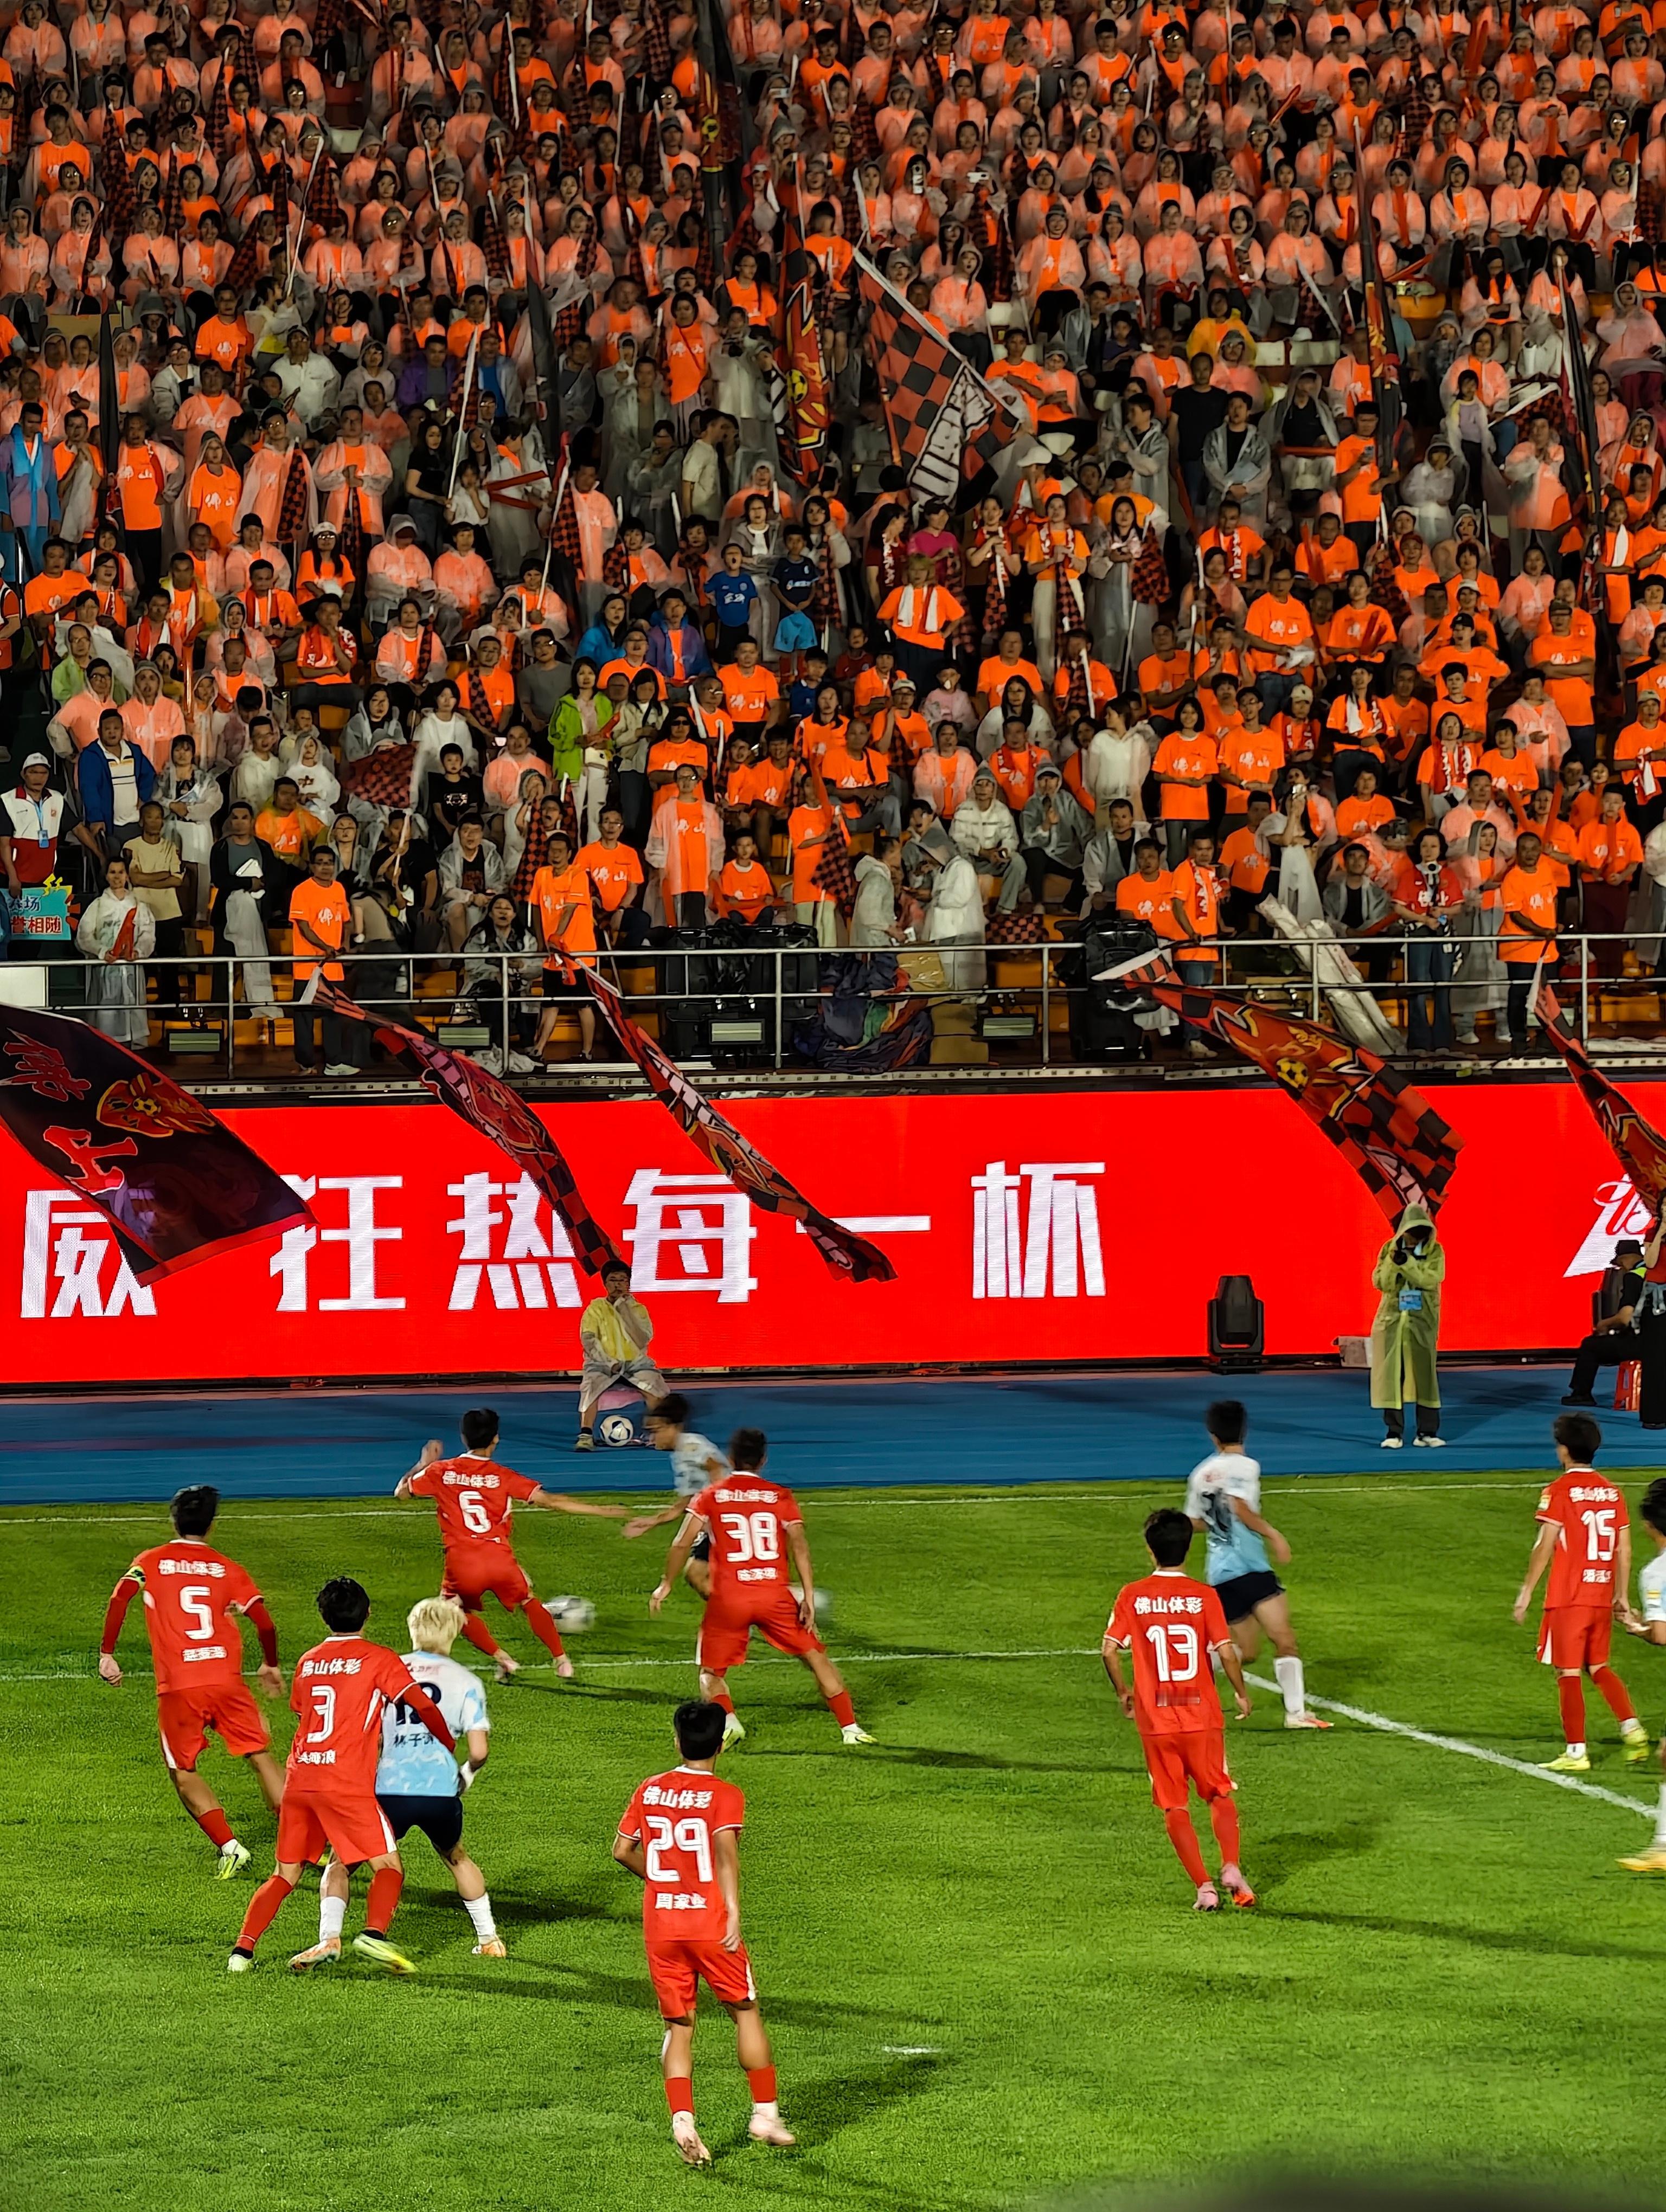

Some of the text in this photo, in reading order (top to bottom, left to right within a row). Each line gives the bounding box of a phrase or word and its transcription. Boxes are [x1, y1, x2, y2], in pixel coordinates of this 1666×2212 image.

[459, 1490, 492, 1534] 6
[720, 1512, 780, 1563] 38
[1580, 1509, 1616, 1561] 15
[180, 1586, 214, 1640] 5
[1134, 1596, 1203, 1615] 佛山体彩
[1145, 1624, 1197, 1682] 13
[306, 1685, 336, 1744] 3
[642, 1785, 714, 1809] 佛山体彩
[645, 1815, 714, 1882] 29
